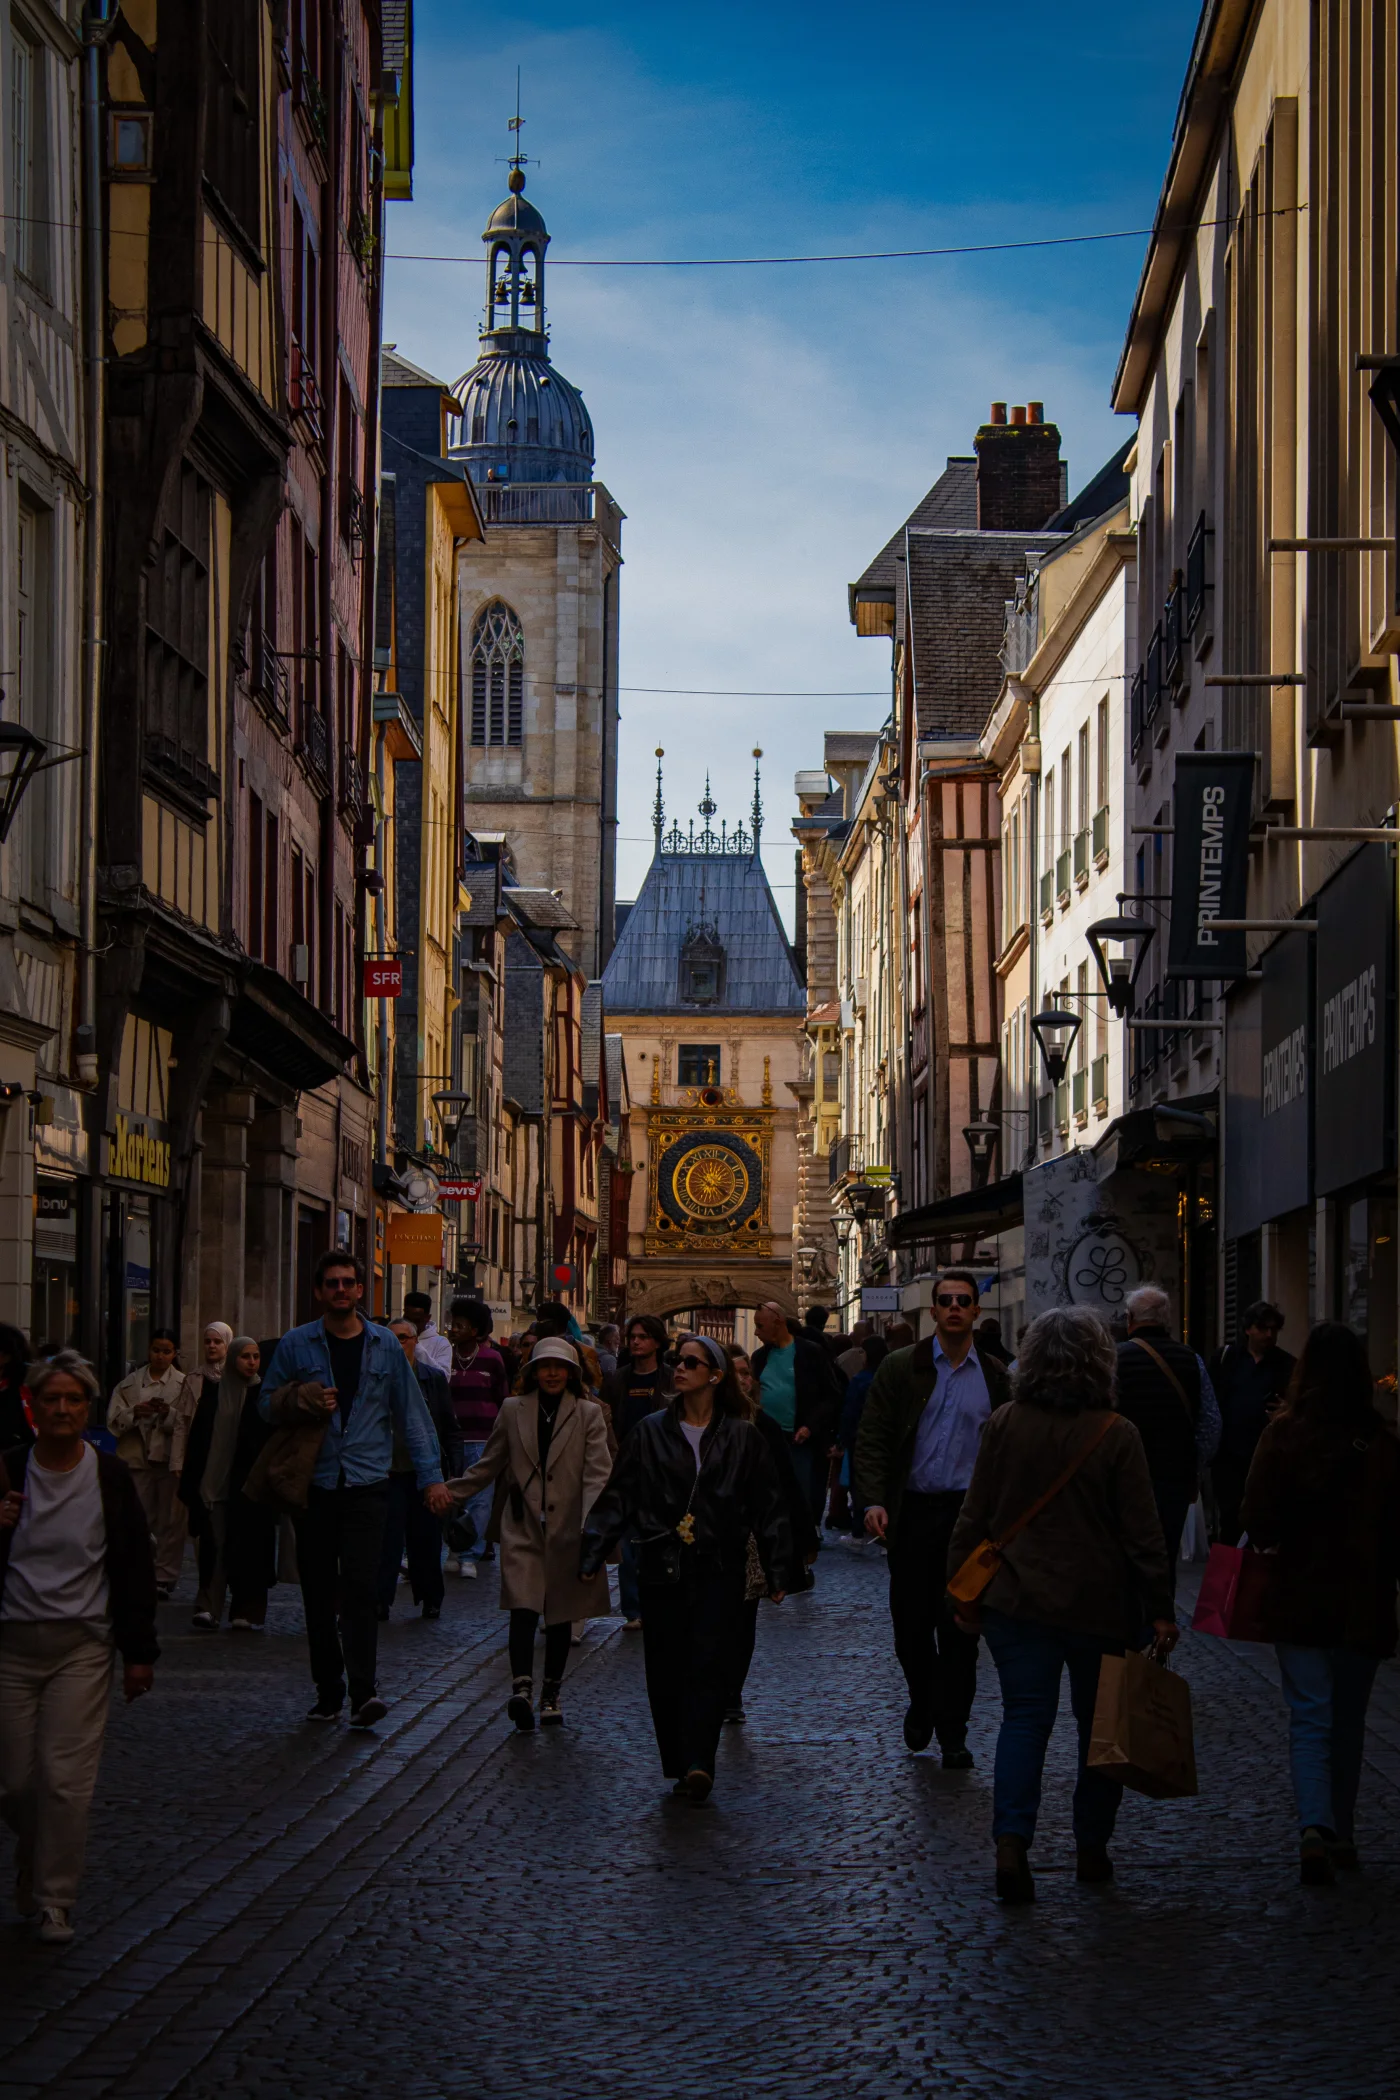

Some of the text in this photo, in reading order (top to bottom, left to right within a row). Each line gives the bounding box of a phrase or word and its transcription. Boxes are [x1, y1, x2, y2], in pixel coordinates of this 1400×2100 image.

[1196, 785, 1225, 946] PRINTEMPS
[372, 972, 401, 985] SFR
[1323, 964, 1376, 1075] PRINTEMPS
[1263, 1024, 1305, 1119] PRINTEMPS
